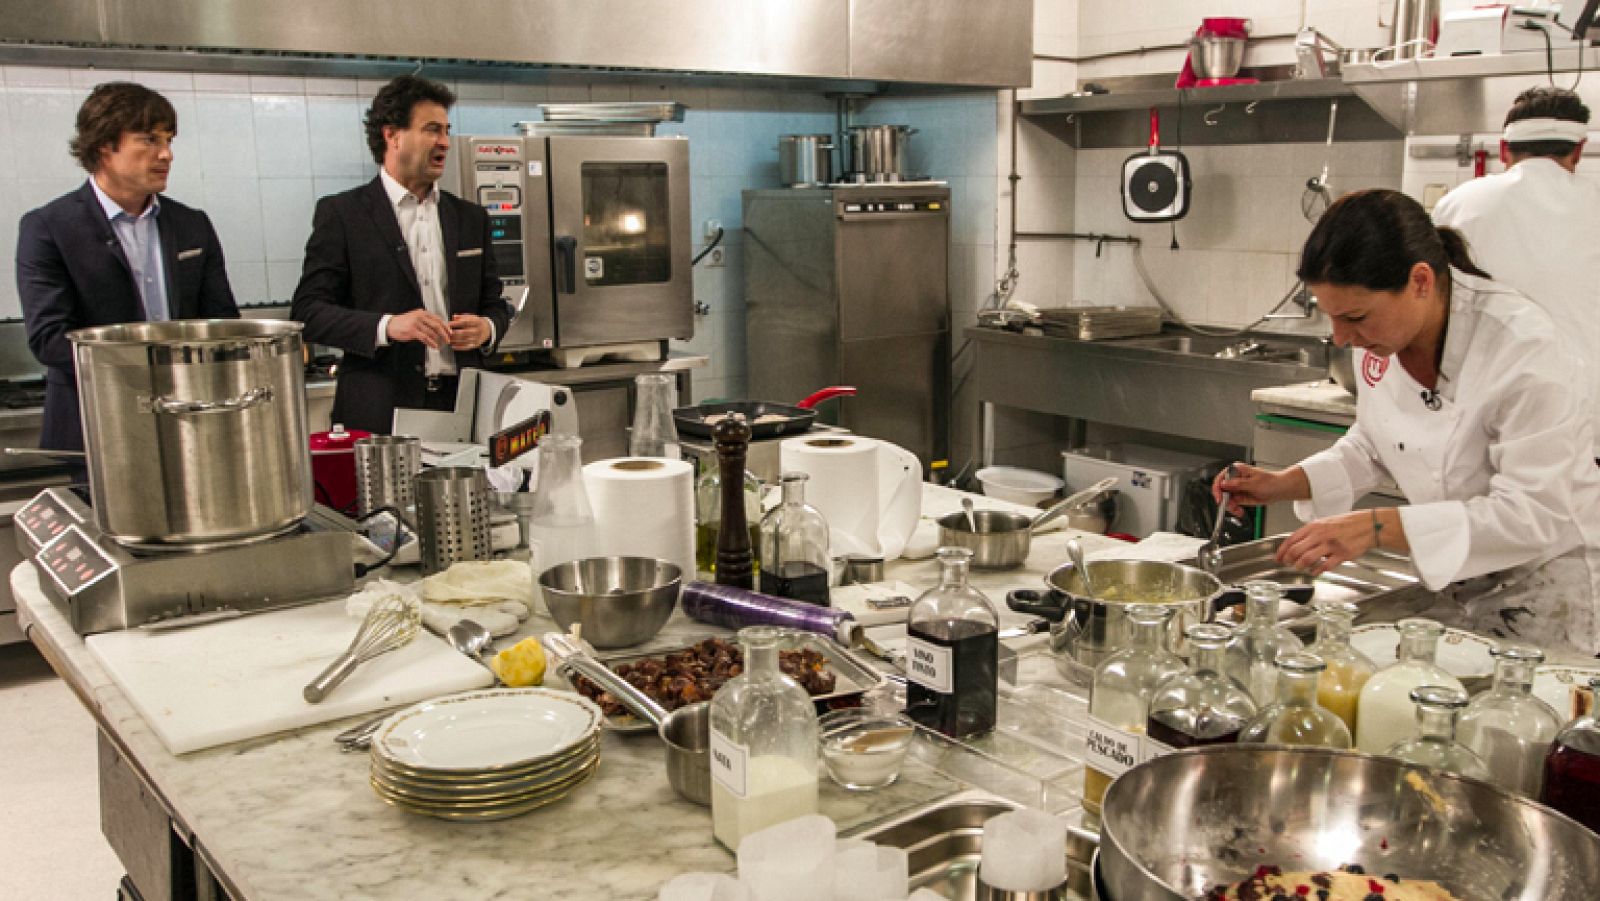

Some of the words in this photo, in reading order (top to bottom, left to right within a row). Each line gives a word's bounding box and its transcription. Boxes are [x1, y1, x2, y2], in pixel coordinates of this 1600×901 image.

[913, 647, 935, 664] VINO
[912, 660, 937, 678] TINTO
[1089, 730, 1115, 747] CALDO
[1117, 741, 1128, 753] DE
[1087, 738, 1134, 766] PESCADO
